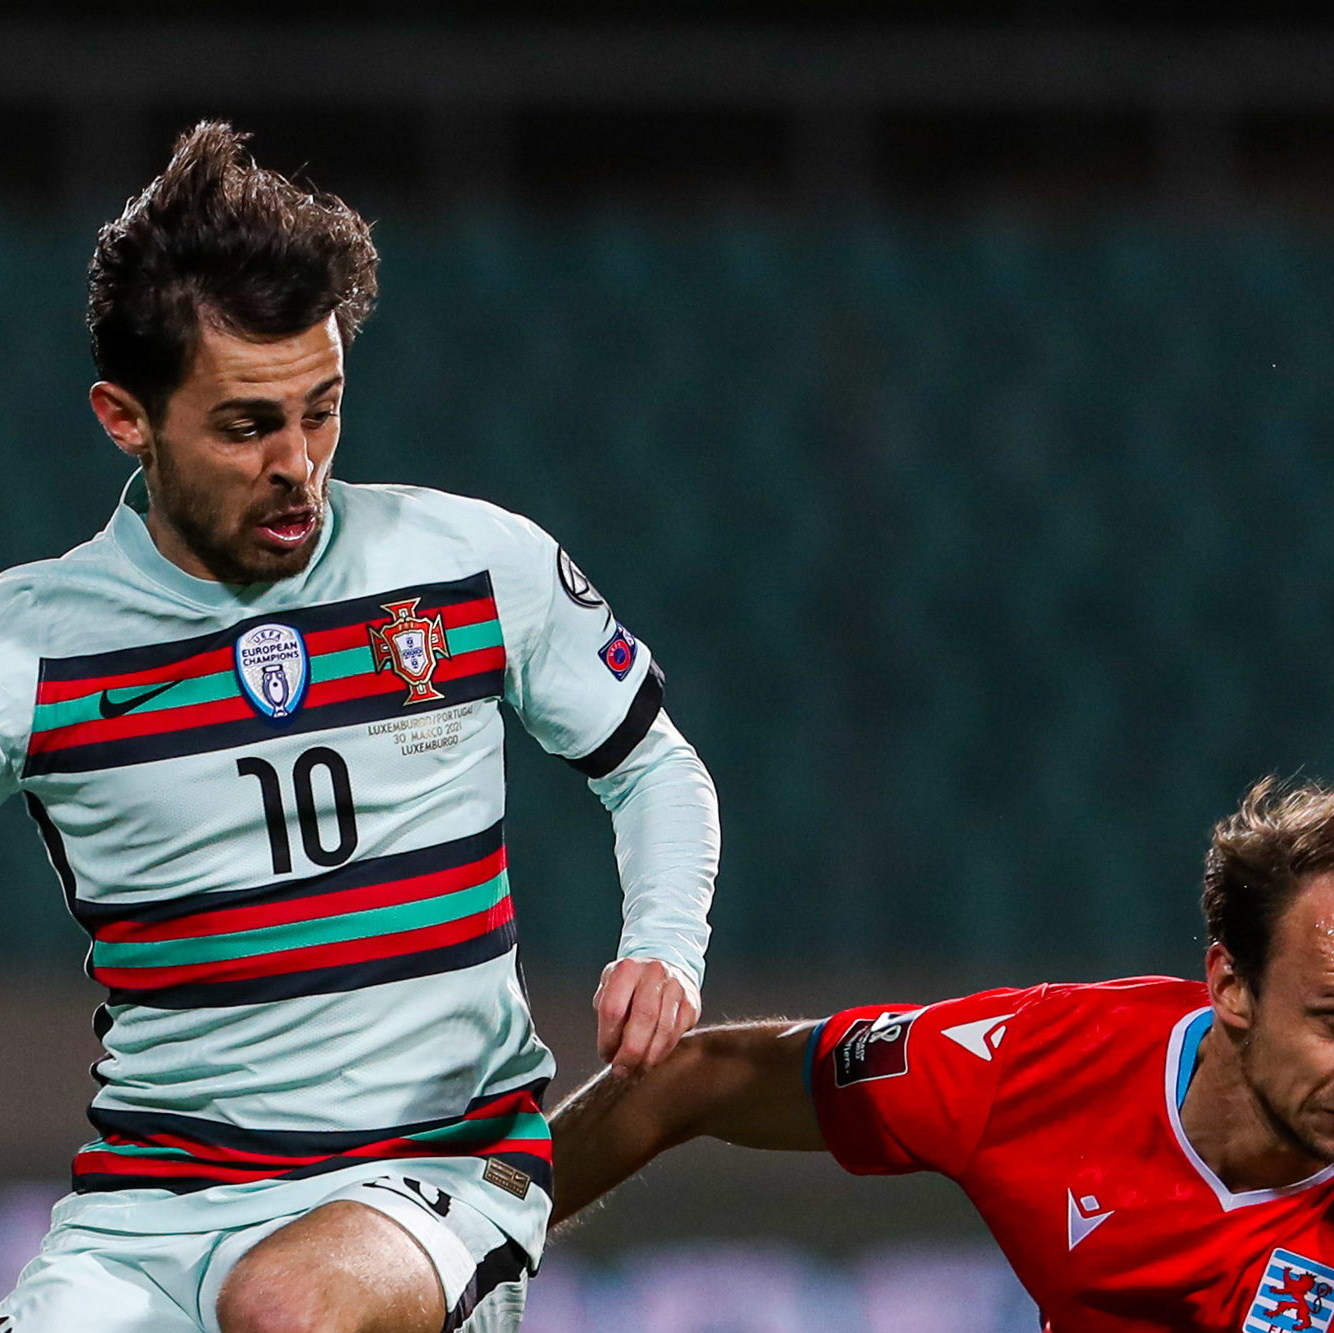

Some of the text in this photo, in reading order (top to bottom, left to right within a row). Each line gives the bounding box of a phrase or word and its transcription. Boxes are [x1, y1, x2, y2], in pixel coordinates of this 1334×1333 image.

[253, 630, 281, 644] UEFA
[242, 641, 298, 658] EUROPEAN
[242, 650, 299, 667] CHAMPIONS
[393, 733, 406, 744] 30
[445, 721, 462, 735] 2021
[402, 735, 458, 756] LUXEMBURGO
[236, 746, 358, 875] 10
